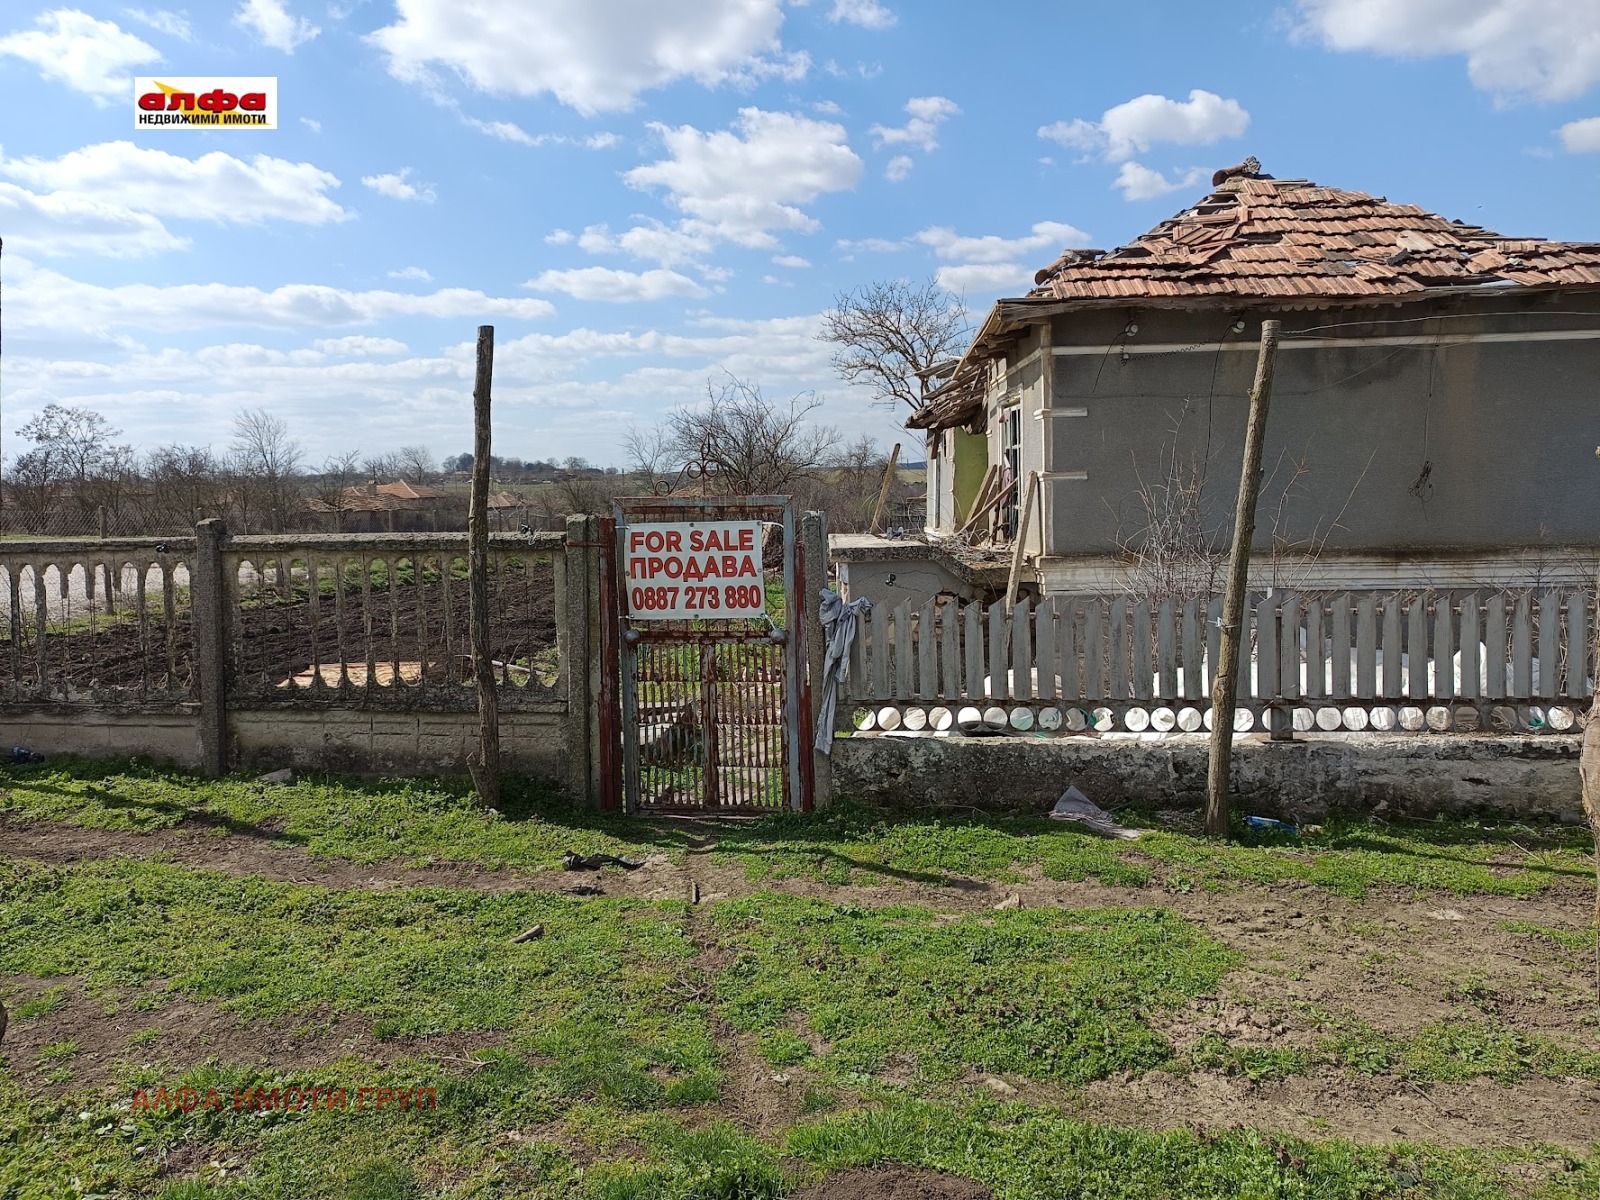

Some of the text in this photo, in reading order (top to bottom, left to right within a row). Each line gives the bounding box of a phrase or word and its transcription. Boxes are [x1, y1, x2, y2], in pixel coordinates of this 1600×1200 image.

[630, 529, 754, 553] FOR SALE
[630, 555, 757, 582] ПРОДАВА
[632, 585, 761, 610] 0887 273 880
